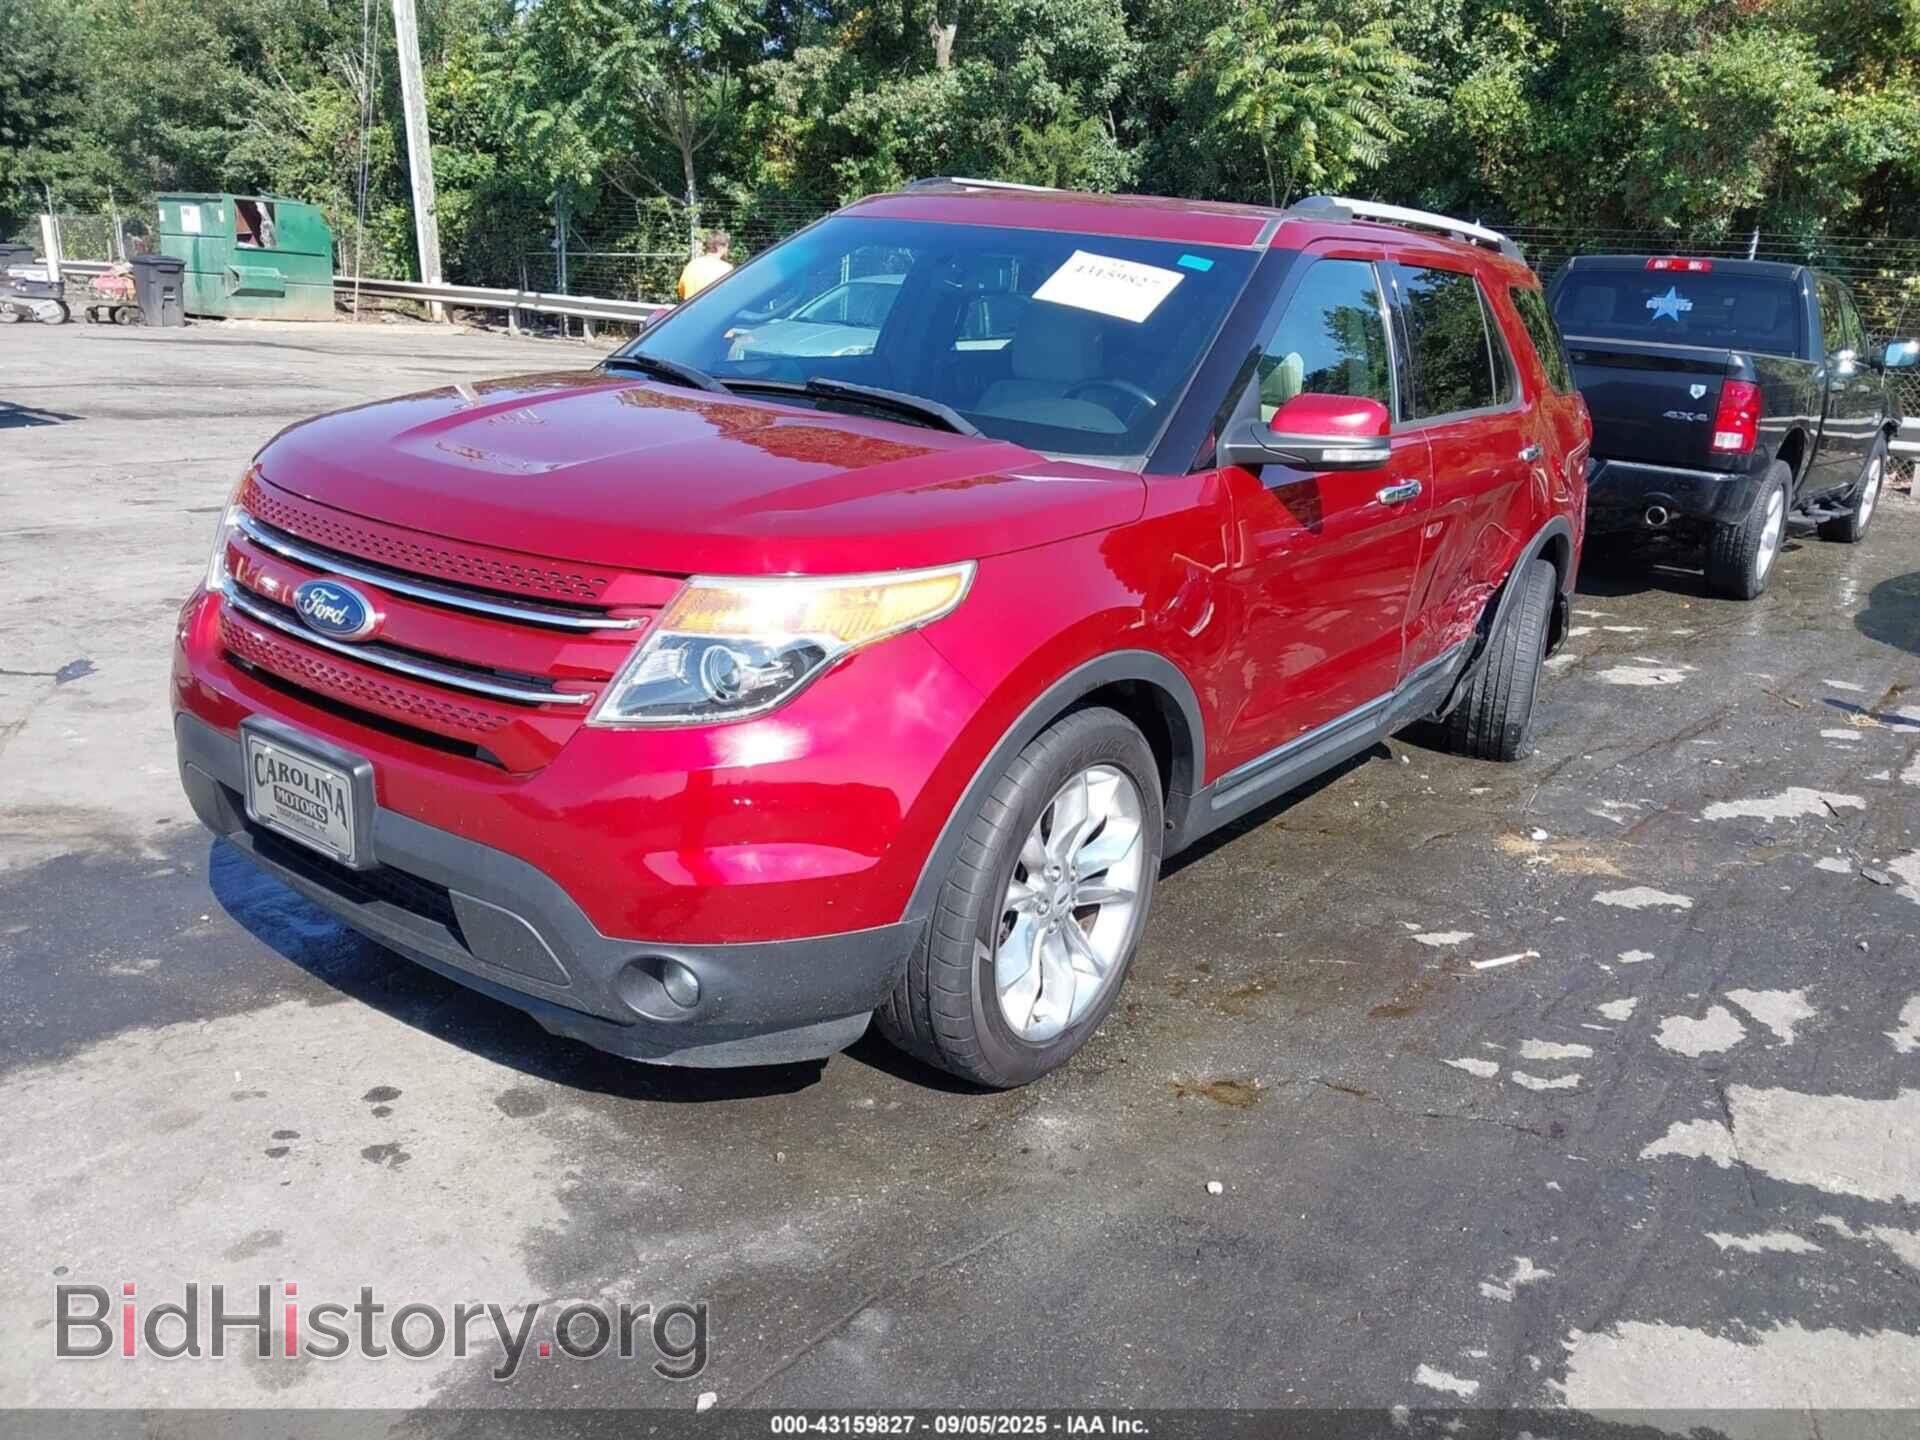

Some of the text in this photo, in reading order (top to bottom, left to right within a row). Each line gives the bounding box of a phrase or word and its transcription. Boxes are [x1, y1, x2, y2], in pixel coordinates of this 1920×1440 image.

[304, 588, 348, 625] Ford
[254, 752, 348, 830] CAROLINA
[275, 786, 327, 822] MOTORS
